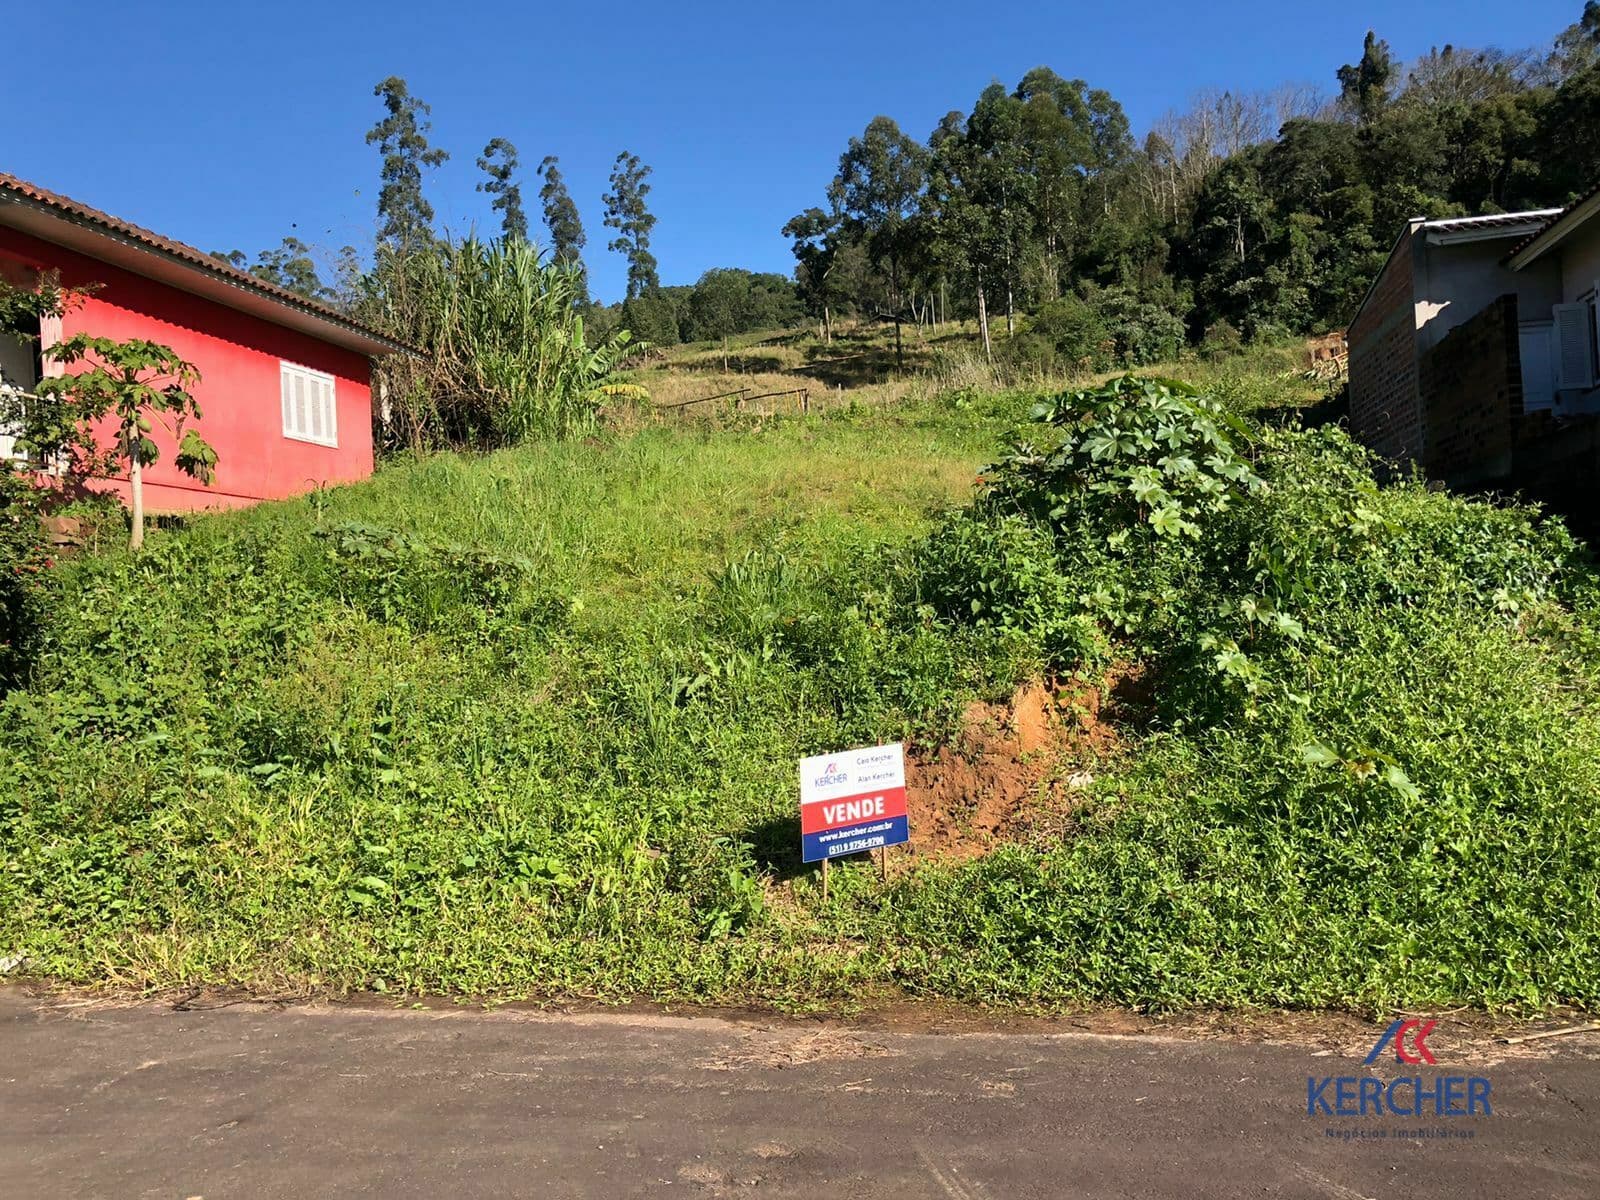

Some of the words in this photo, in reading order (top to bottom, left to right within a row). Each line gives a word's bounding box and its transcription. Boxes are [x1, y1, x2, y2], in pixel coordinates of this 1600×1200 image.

[870, 754, 893, 763] Kercher
[814, 773, 848, 787] KERCHER
[858, 775, 871, 783] Alan
[872, 771, 895, 780] Kercher
[823, 796, 885, 824] VENDE
[819, 822, 893, 842] www.kercher.com.br
[828, 844, 842, 855] (51)
